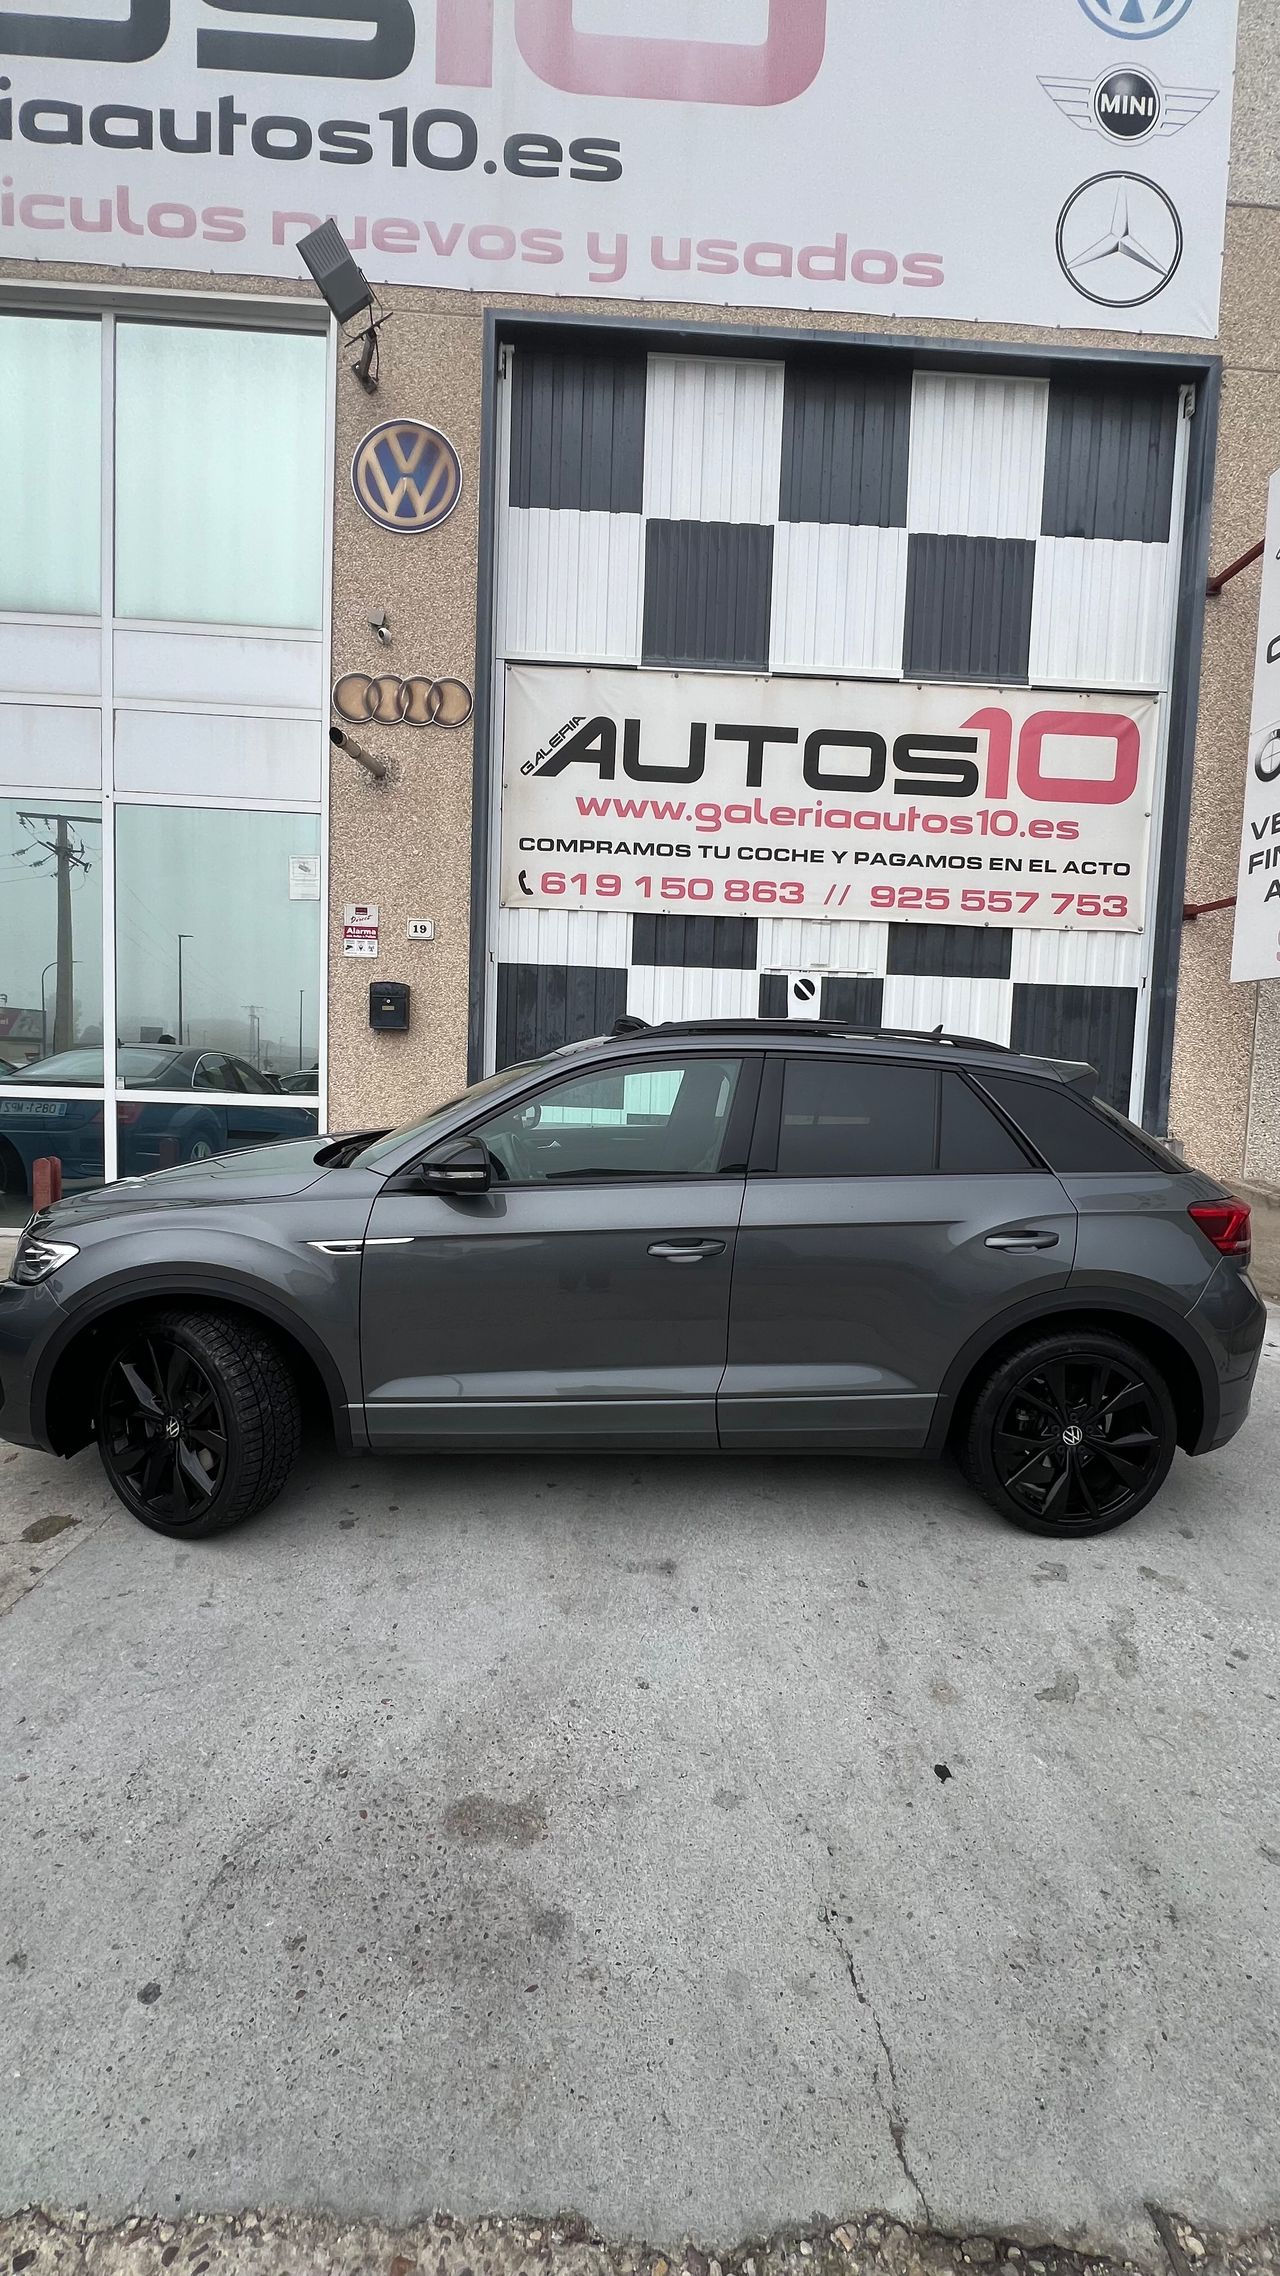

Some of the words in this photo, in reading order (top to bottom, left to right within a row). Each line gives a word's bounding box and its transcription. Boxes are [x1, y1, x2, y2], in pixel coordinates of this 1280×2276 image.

[1100, 93, 1154, 117] MINI
[587, 232, 628, 283] y
[650, 233, 945, 288] usados
[519, 715, 587, 776] GALERIA
[575, 796, 1080, 840] www.galeriaautos10.es
[518, 837, 691, 858] COMPRAMOS
[698, 844, 731, 860] TU
[737, 846, 825, 863] COCHE
[831, 850, 848, 864] Y
[854, 851, 982, 870] PAGAMOS
[989, 857, 1023, 872] EN
[1029, 859, 1057, 873] EL
[1062, 860, 1131, 876] ACTO
[541, 871, 622, 897] 619
[635, 875, 714, 901] 150
[724, 879, 805, 905] 863
[869, 884, 950, 910] 925
[960, 888, 1040, 914] 557
[1050, 891, 1128, 918] 753
[346, 927, 377, 936] Alarma
[413, 924, 427, 934] 19
